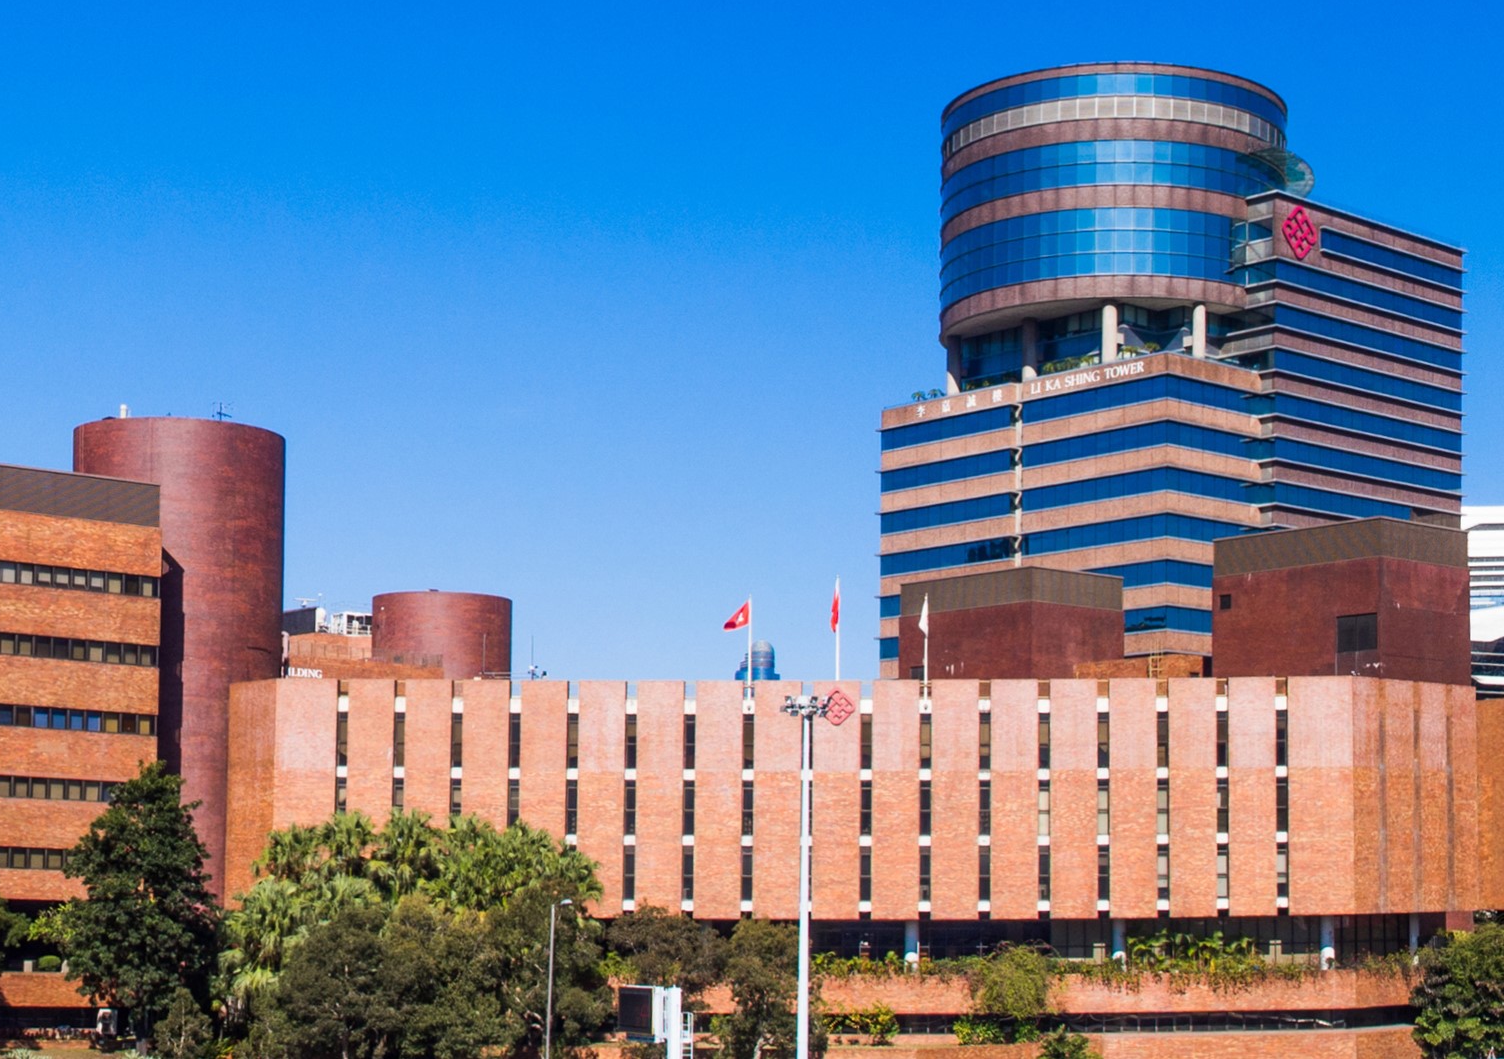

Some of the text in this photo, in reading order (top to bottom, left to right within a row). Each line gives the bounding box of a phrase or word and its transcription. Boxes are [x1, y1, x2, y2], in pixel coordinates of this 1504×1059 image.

[1030, 361, 1145, 394] LI KA SHING TOWER
